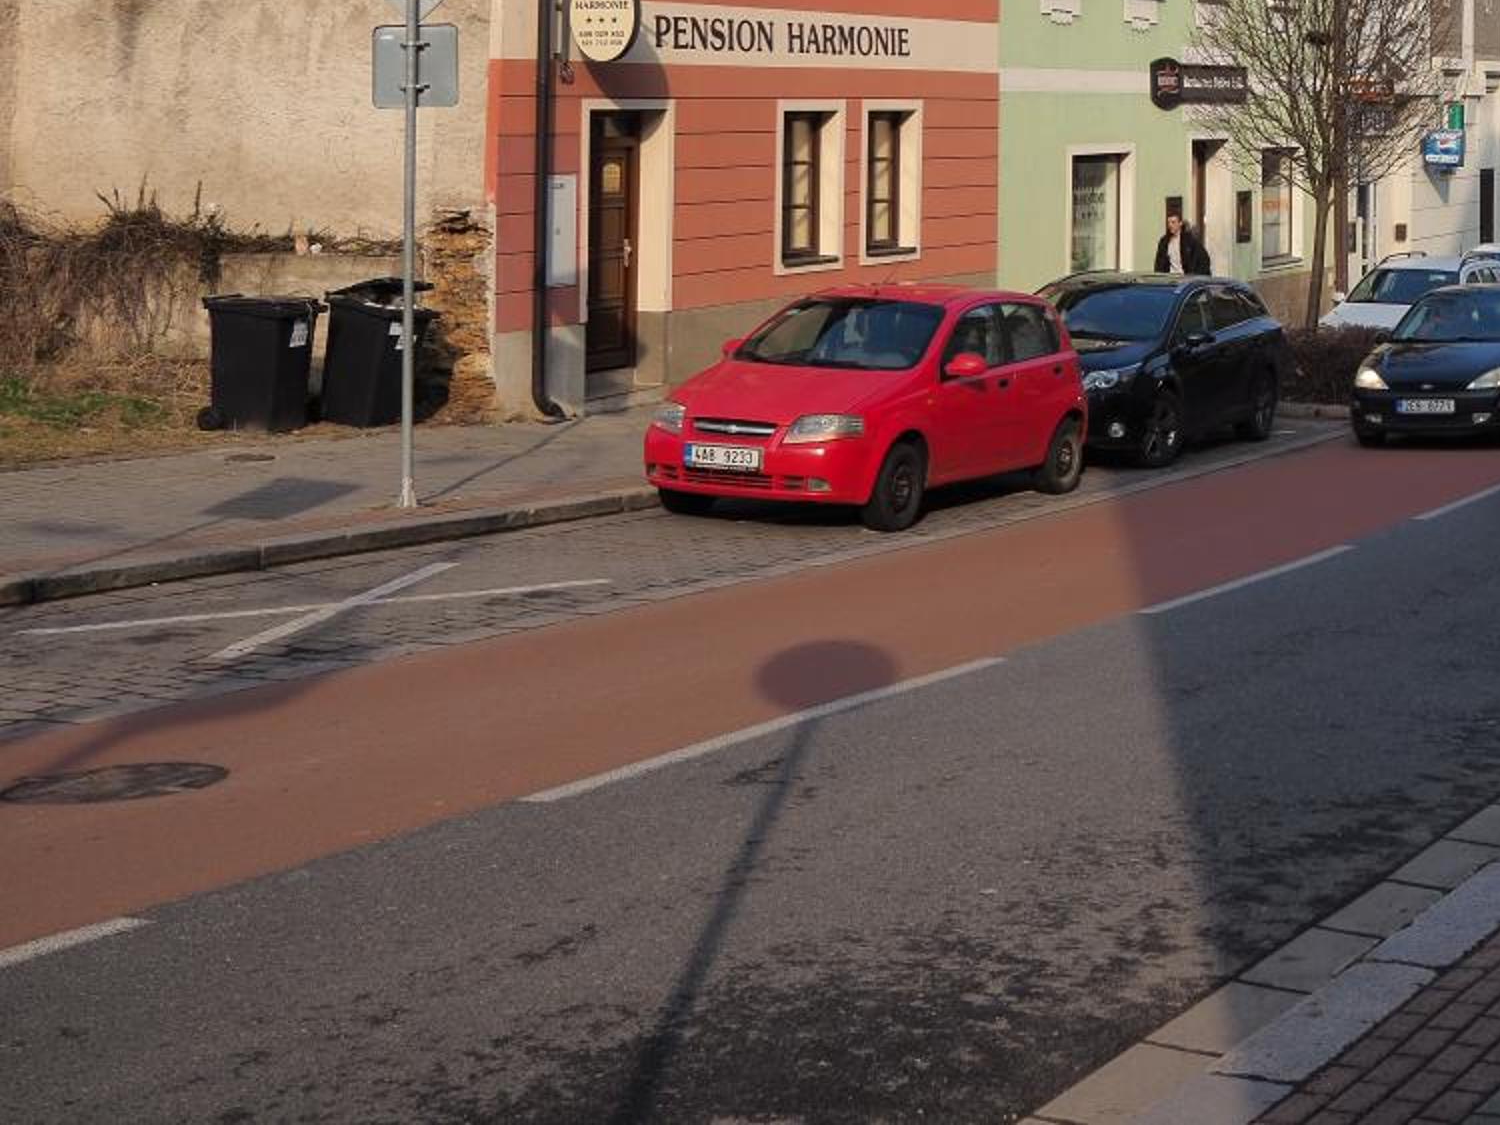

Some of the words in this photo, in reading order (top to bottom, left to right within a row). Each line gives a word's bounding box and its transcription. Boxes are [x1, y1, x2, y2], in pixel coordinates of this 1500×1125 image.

[575, 0, 630, 10] HARMONIE
[655, 15, 774, 52] PENSION
[788, 23, 911, 57] HARMONIE
